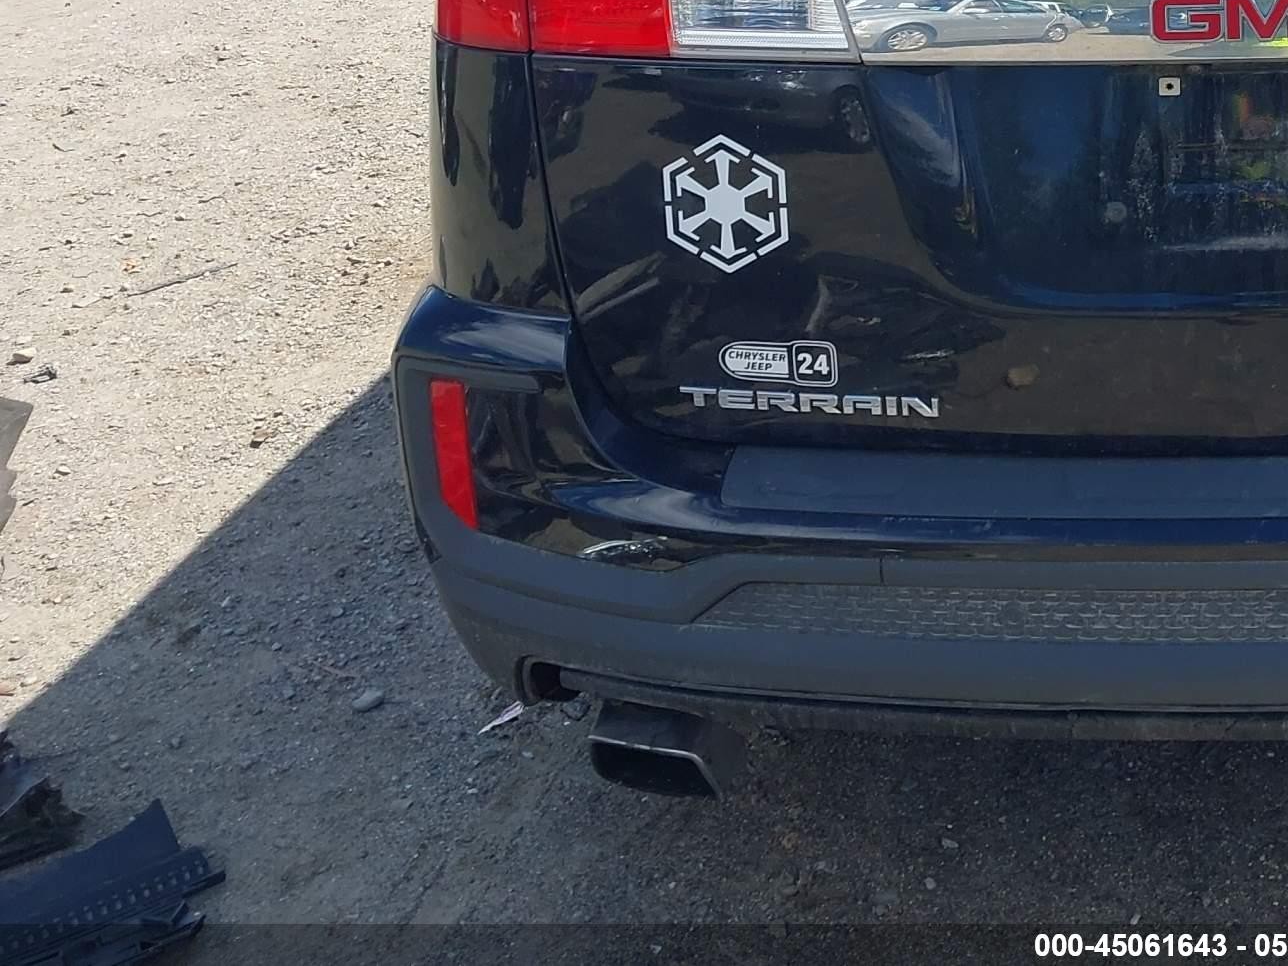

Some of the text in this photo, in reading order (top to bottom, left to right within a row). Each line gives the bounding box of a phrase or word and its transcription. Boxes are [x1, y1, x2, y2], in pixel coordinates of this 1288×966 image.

[728, 350, 786, 362] CHRYSLER
[797, 352, 830, 375] 24
[744, 361, 773, 371] JEEP
[679, 386, 940, 418] TERRAIN
